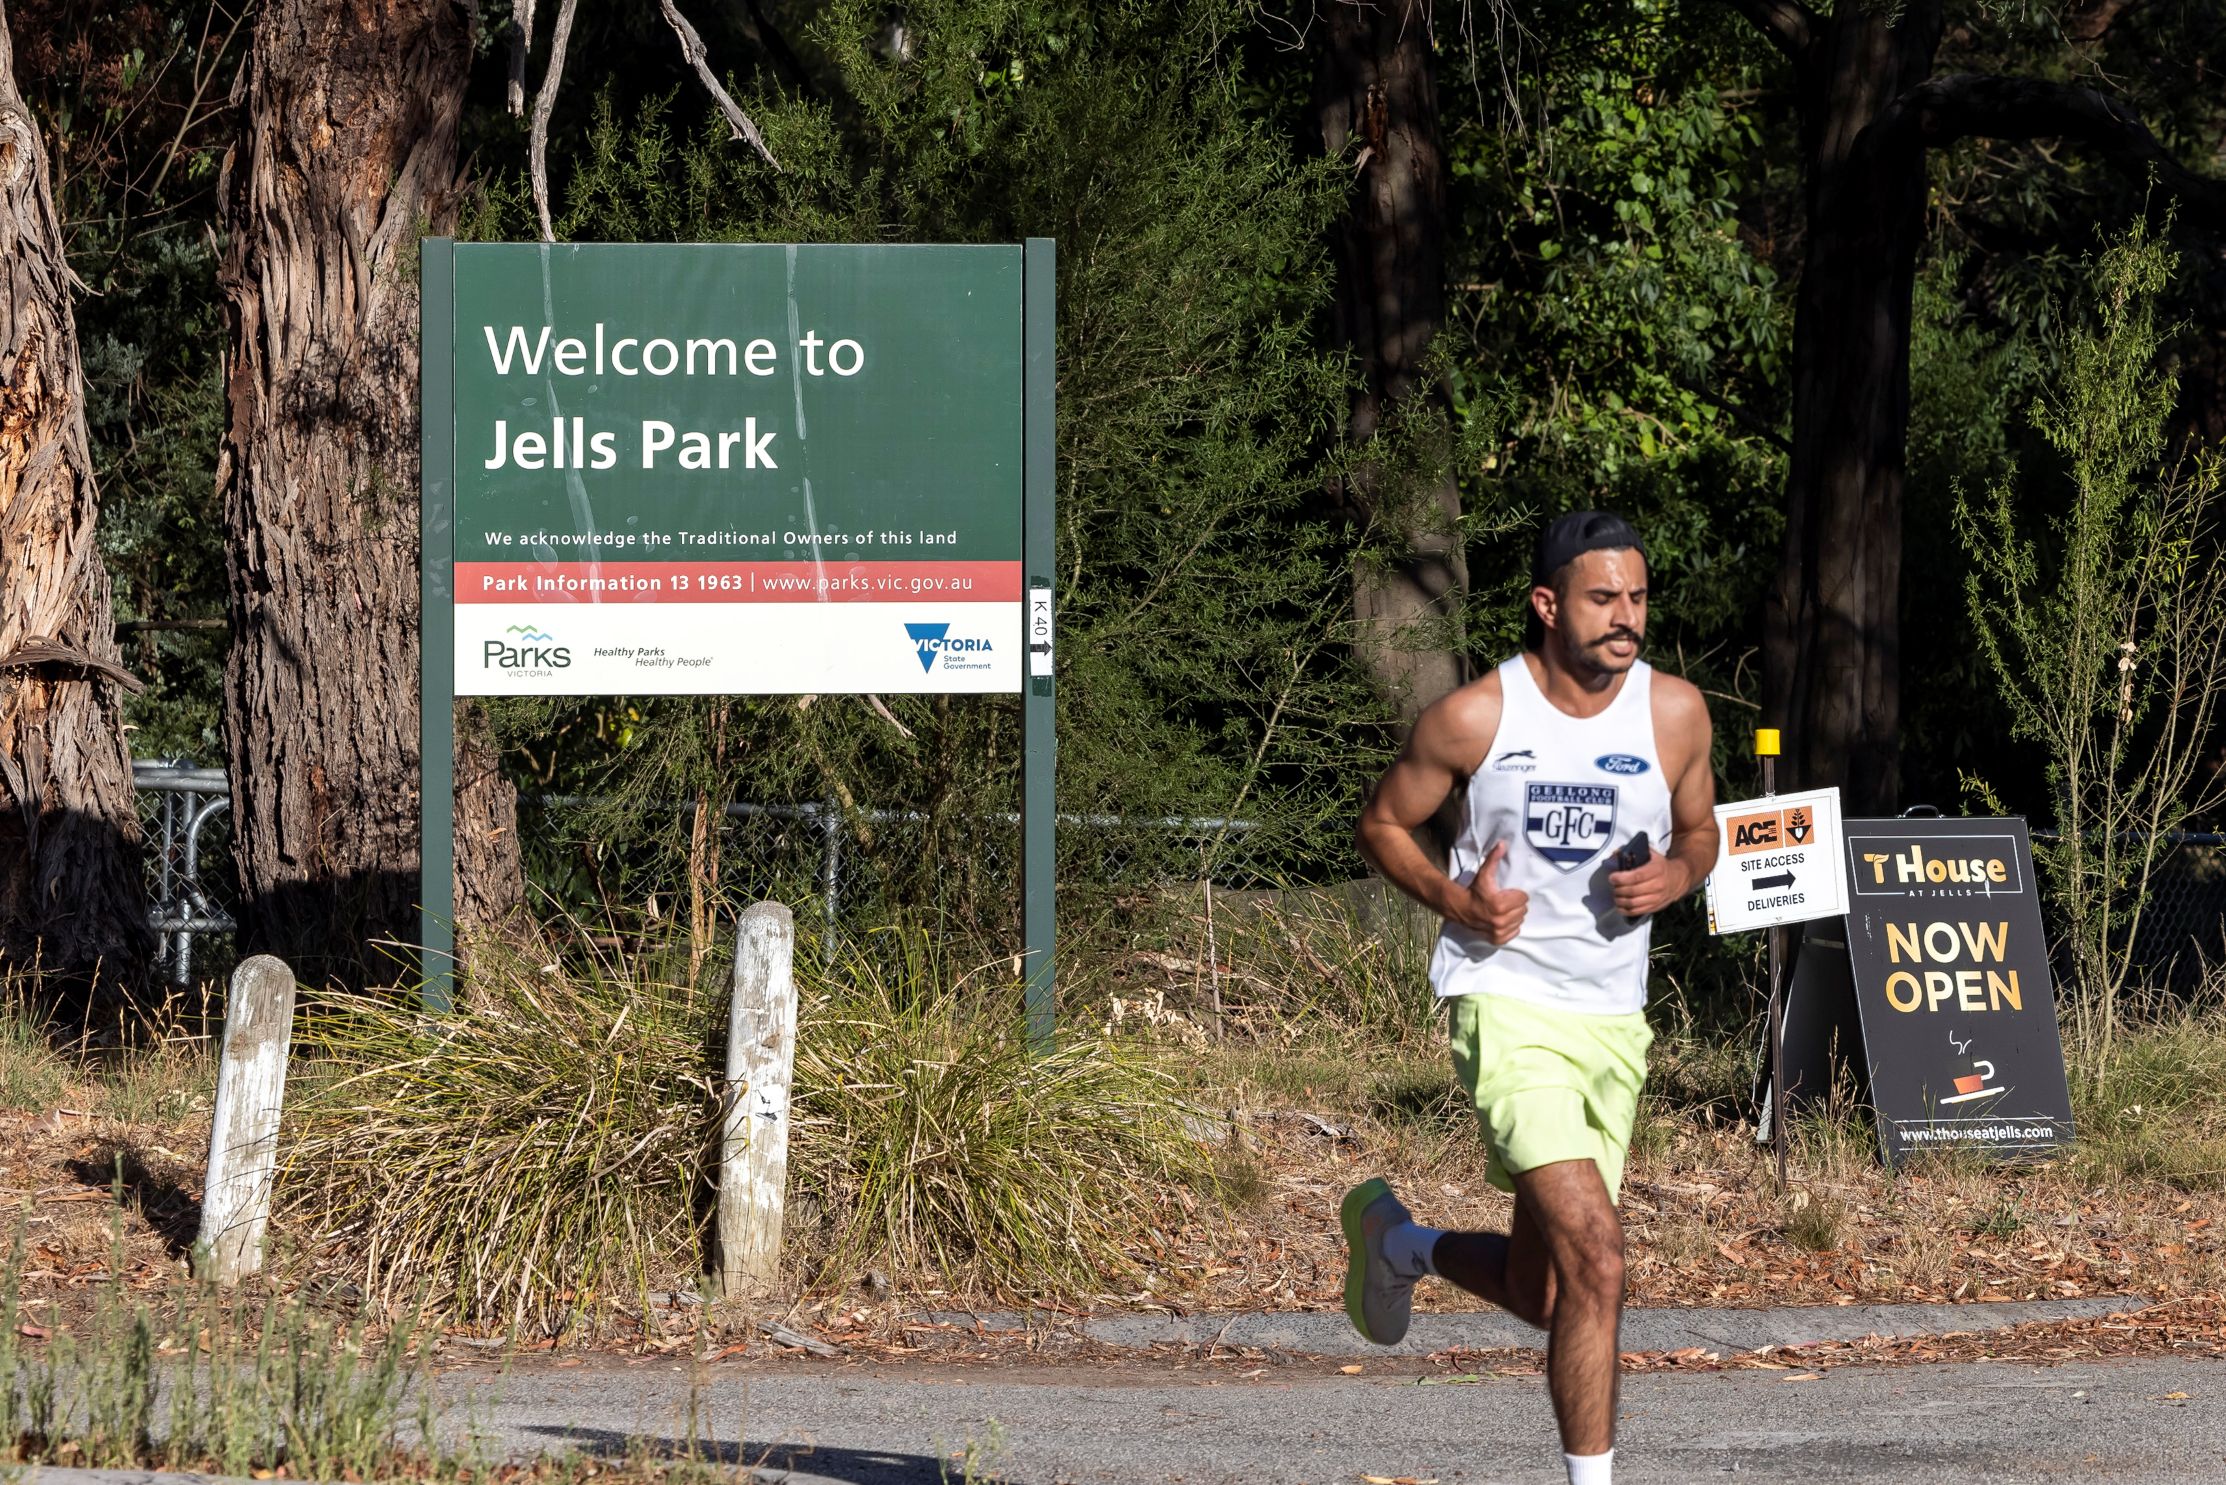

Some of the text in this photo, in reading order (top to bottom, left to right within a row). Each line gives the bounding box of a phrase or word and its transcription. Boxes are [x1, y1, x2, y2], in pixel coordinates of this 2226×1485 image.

[483, 322, 865, 376] Welcome to
[484, 416, 778, 470] Jells Park
[485, 530, 957, 548] We acknowledge the Traditional Owners of this land
[483, 574, 743, 591] Park Information 13 1963
[763, 573, 973, 593] www.parks.vic.gov.au
[1034, 601, 1049, 637] K 40
[484, 640, 572, 669] Parks
[594, 647, 666, 659] Healthy Parks
[911, 639, 993, 652] VICTORIA
[635, 657, 675, 668] Healthy
[943, 655, 966, 663] State
[507, 670, 553, 678] VICTORIA
[1604, 757, 1641, 774] Ford
[1530, 786, 1613, 798] GEELONG
[1546, 806, 1594, 845] GFC
[1735, 820, 1778, 847] ACE
[1741, 853, 1805, 872] SITE ACCESS
[1895, 845, 2007, 883] House
[1747, 893, 1805, 911] DELIVERIES
[1931, 889, 1972, 897] JELLS
[1886, 922, 2009, 964] NOW
[1885, 970, 2023, 1013] OPEN
